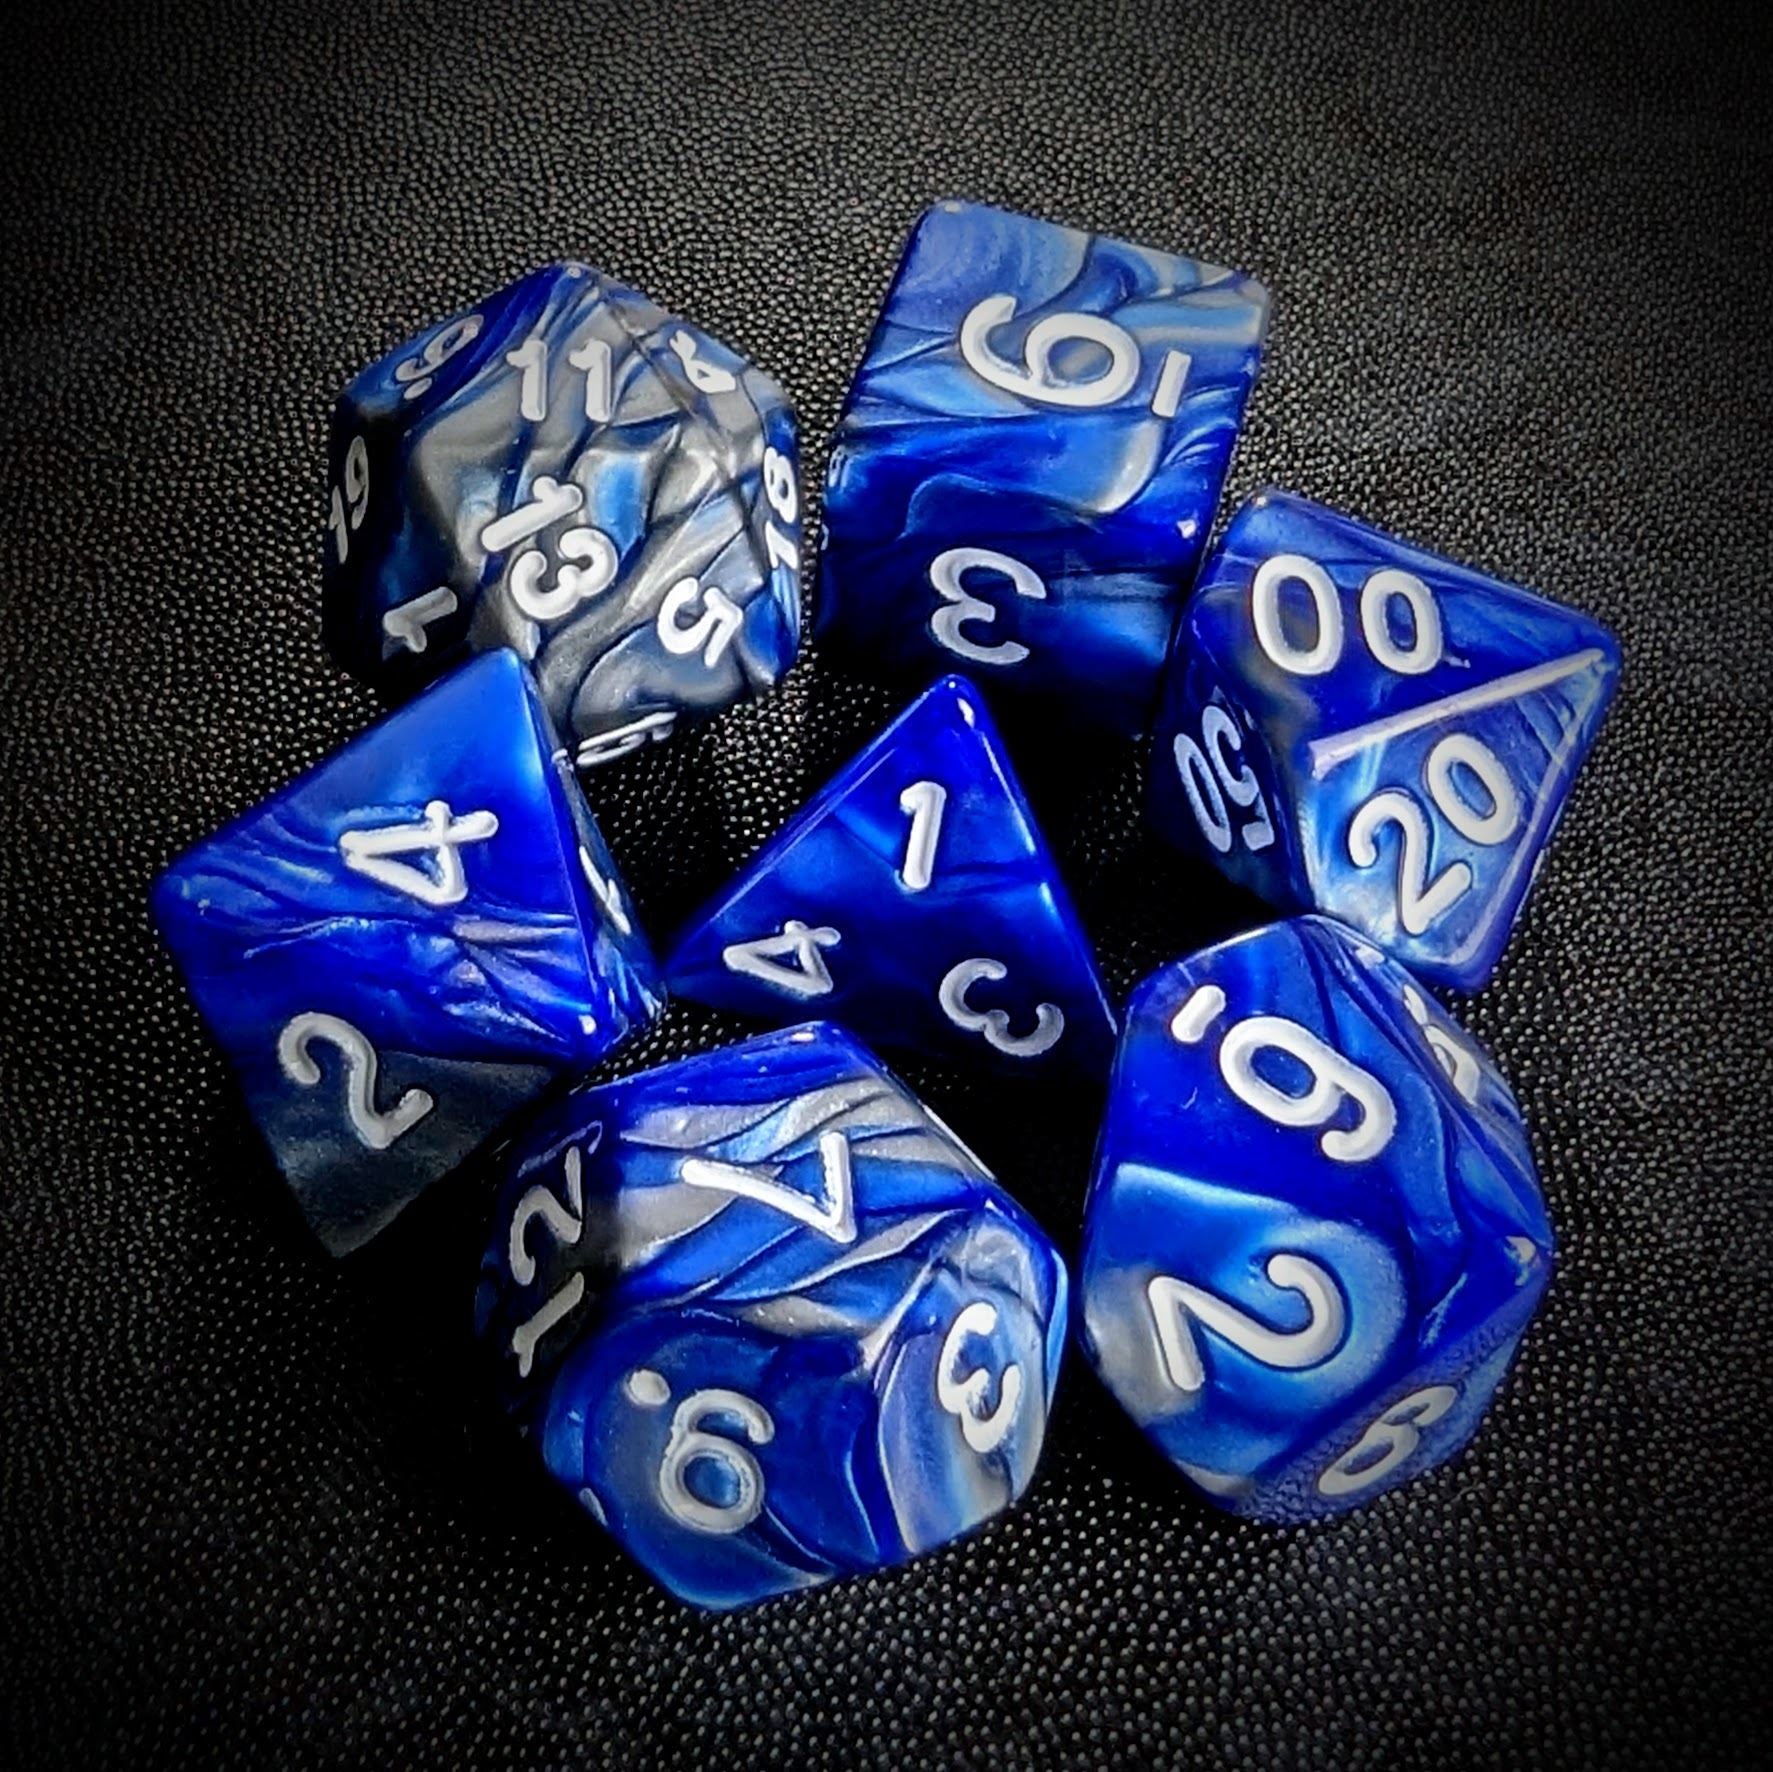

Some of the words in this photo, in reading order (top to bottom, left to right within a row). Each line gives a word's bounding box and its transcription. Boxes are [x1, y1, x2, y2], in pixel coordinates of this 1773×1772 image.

[505, 338, 612, 422] 11
[480, 475, 619, 621] 13
[929, 547, 1048, 666] 3
[656, 576, 744, 668] 5
[1251, 553, 1445, 676] 00
[899, 780, 947, 890] 1
[1172, 705, 1276, 854] 50
[1347, 731, 1520, 937] 20
[338, 799, 500, 906] 4
[722, 918, 842, 996] 4
[938, 956, 1066, 1058] 3
[277, 1010, 435, 1151] 2
[680, 1129, 859, 1244] 7
[508, 1146, 585, 1379] 12
[1146, 1251, 1349, 1393] 2
[936, 1300, 1022, 1454] 3
